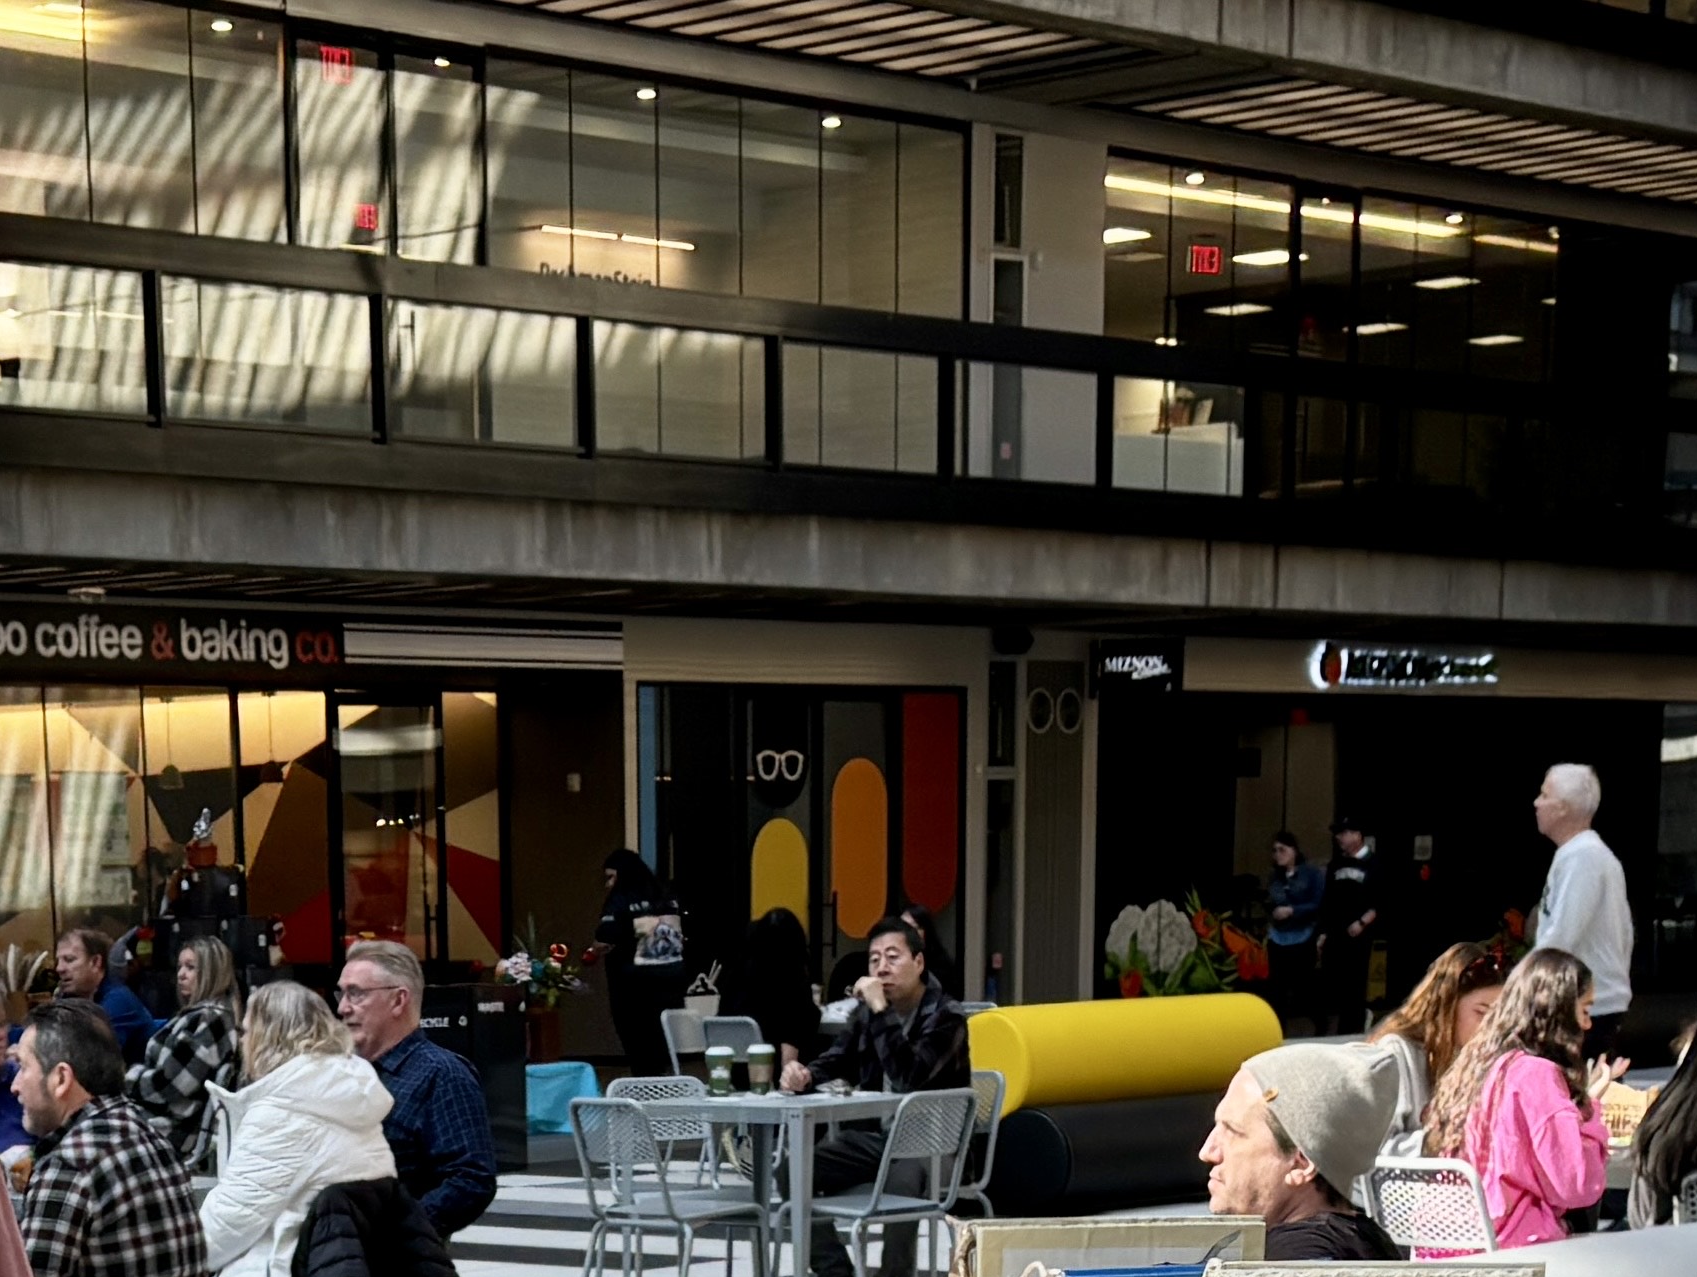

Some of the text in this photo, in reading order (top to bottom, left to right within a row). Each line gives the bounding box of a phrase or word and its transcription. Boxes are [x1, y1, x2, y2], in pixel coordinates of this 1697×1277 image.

[34, 614, 143, 660] coffee
[150, 620, 175, 661] &
[180, 618, 290, 669] baking
[295, 630, 338, 664] co.
